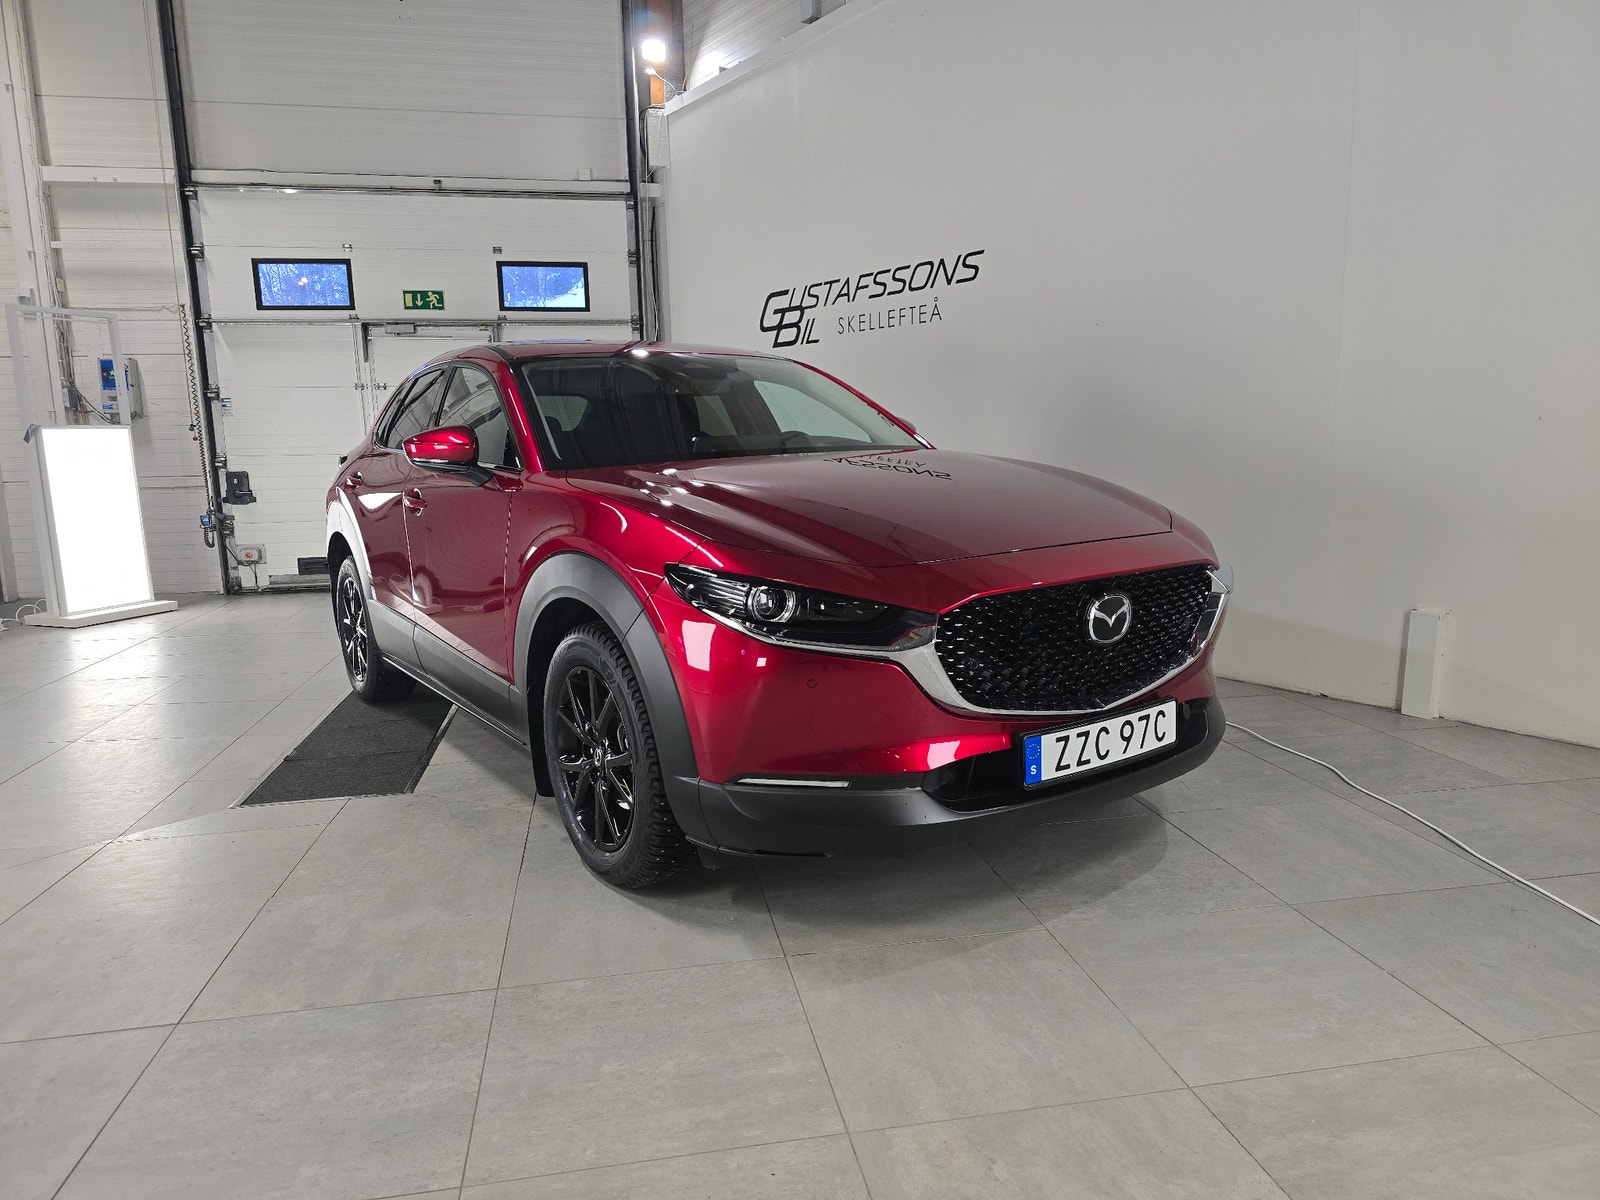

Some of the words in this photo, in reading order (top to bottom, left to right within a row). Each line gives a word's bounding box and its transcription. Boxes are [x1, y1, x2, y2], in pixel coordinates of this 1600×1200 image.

[759, 249, 985, 332] GUSTAFSSONS
[772, 304, 820, 348] BIL
[837, 296, 942, 334] SKELLEFTEÅ
[1055, 726, 1110, 772] ZZC
[1119, 709, 1166, 754] 97C
[1030, 765, 1037, 775] S
